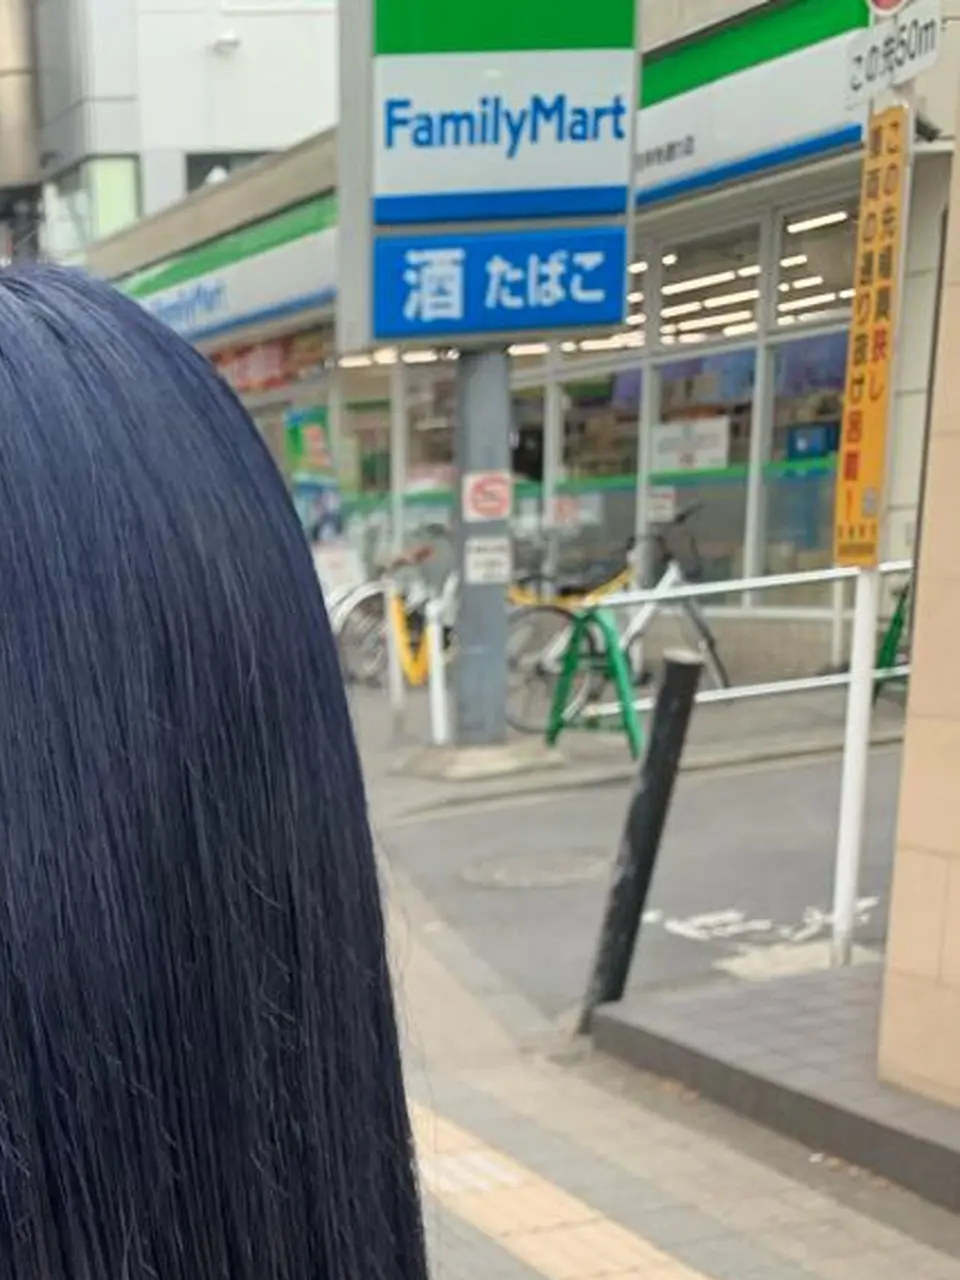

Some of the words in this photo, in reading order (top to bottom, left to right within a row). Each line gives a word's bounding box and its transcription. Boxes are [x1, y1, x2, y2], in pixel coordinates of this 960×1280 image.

[384, 94, 626, 159] FamilyMart
[403, 247, 465, 322] 酒
[484, 250, 606, 309] たばこ
